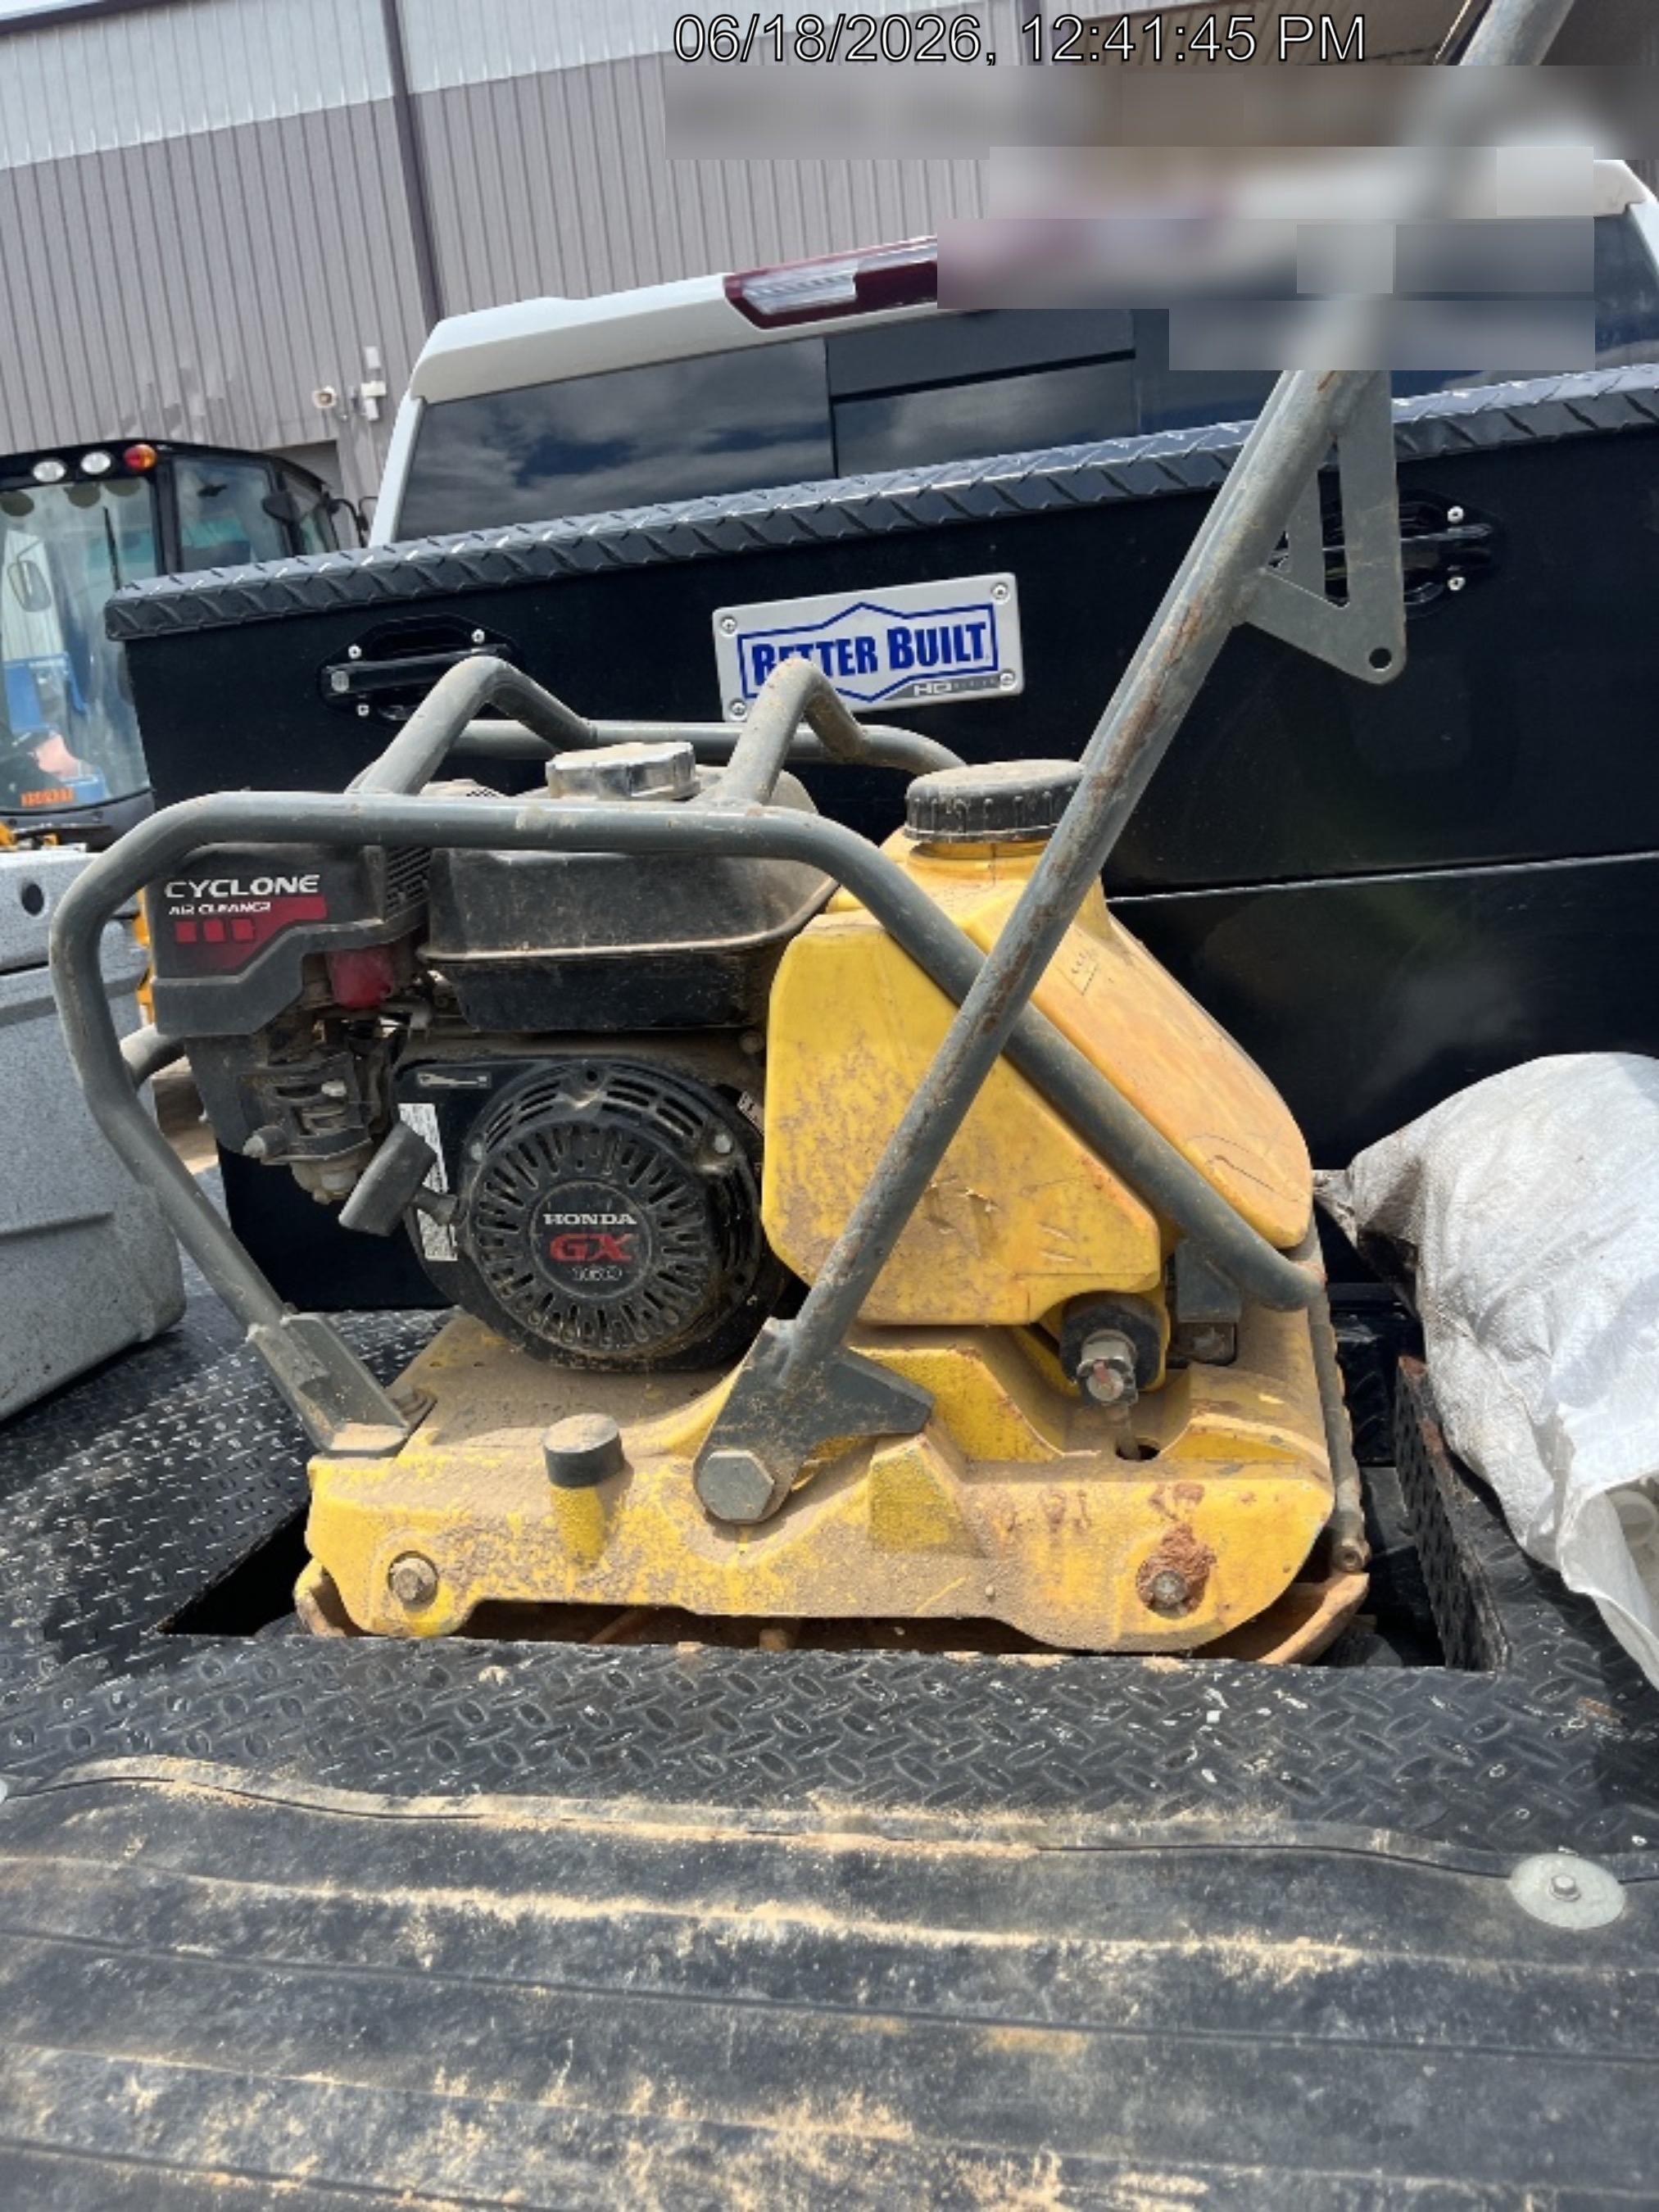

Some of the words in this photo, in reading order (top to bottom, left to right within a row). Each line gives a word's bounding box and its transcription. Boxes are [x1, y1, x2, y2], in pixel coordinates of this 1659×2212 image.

[886, 622, 986, 670] BUILT
[165, 874, 320, 899] CYCLONE
[169, 904, 194, 915] AIR
[198, 901, 271, 915] CLEANER
[543, 1213, 637, 1226] HONDA
[550, 1233, 633, 1262] GX
